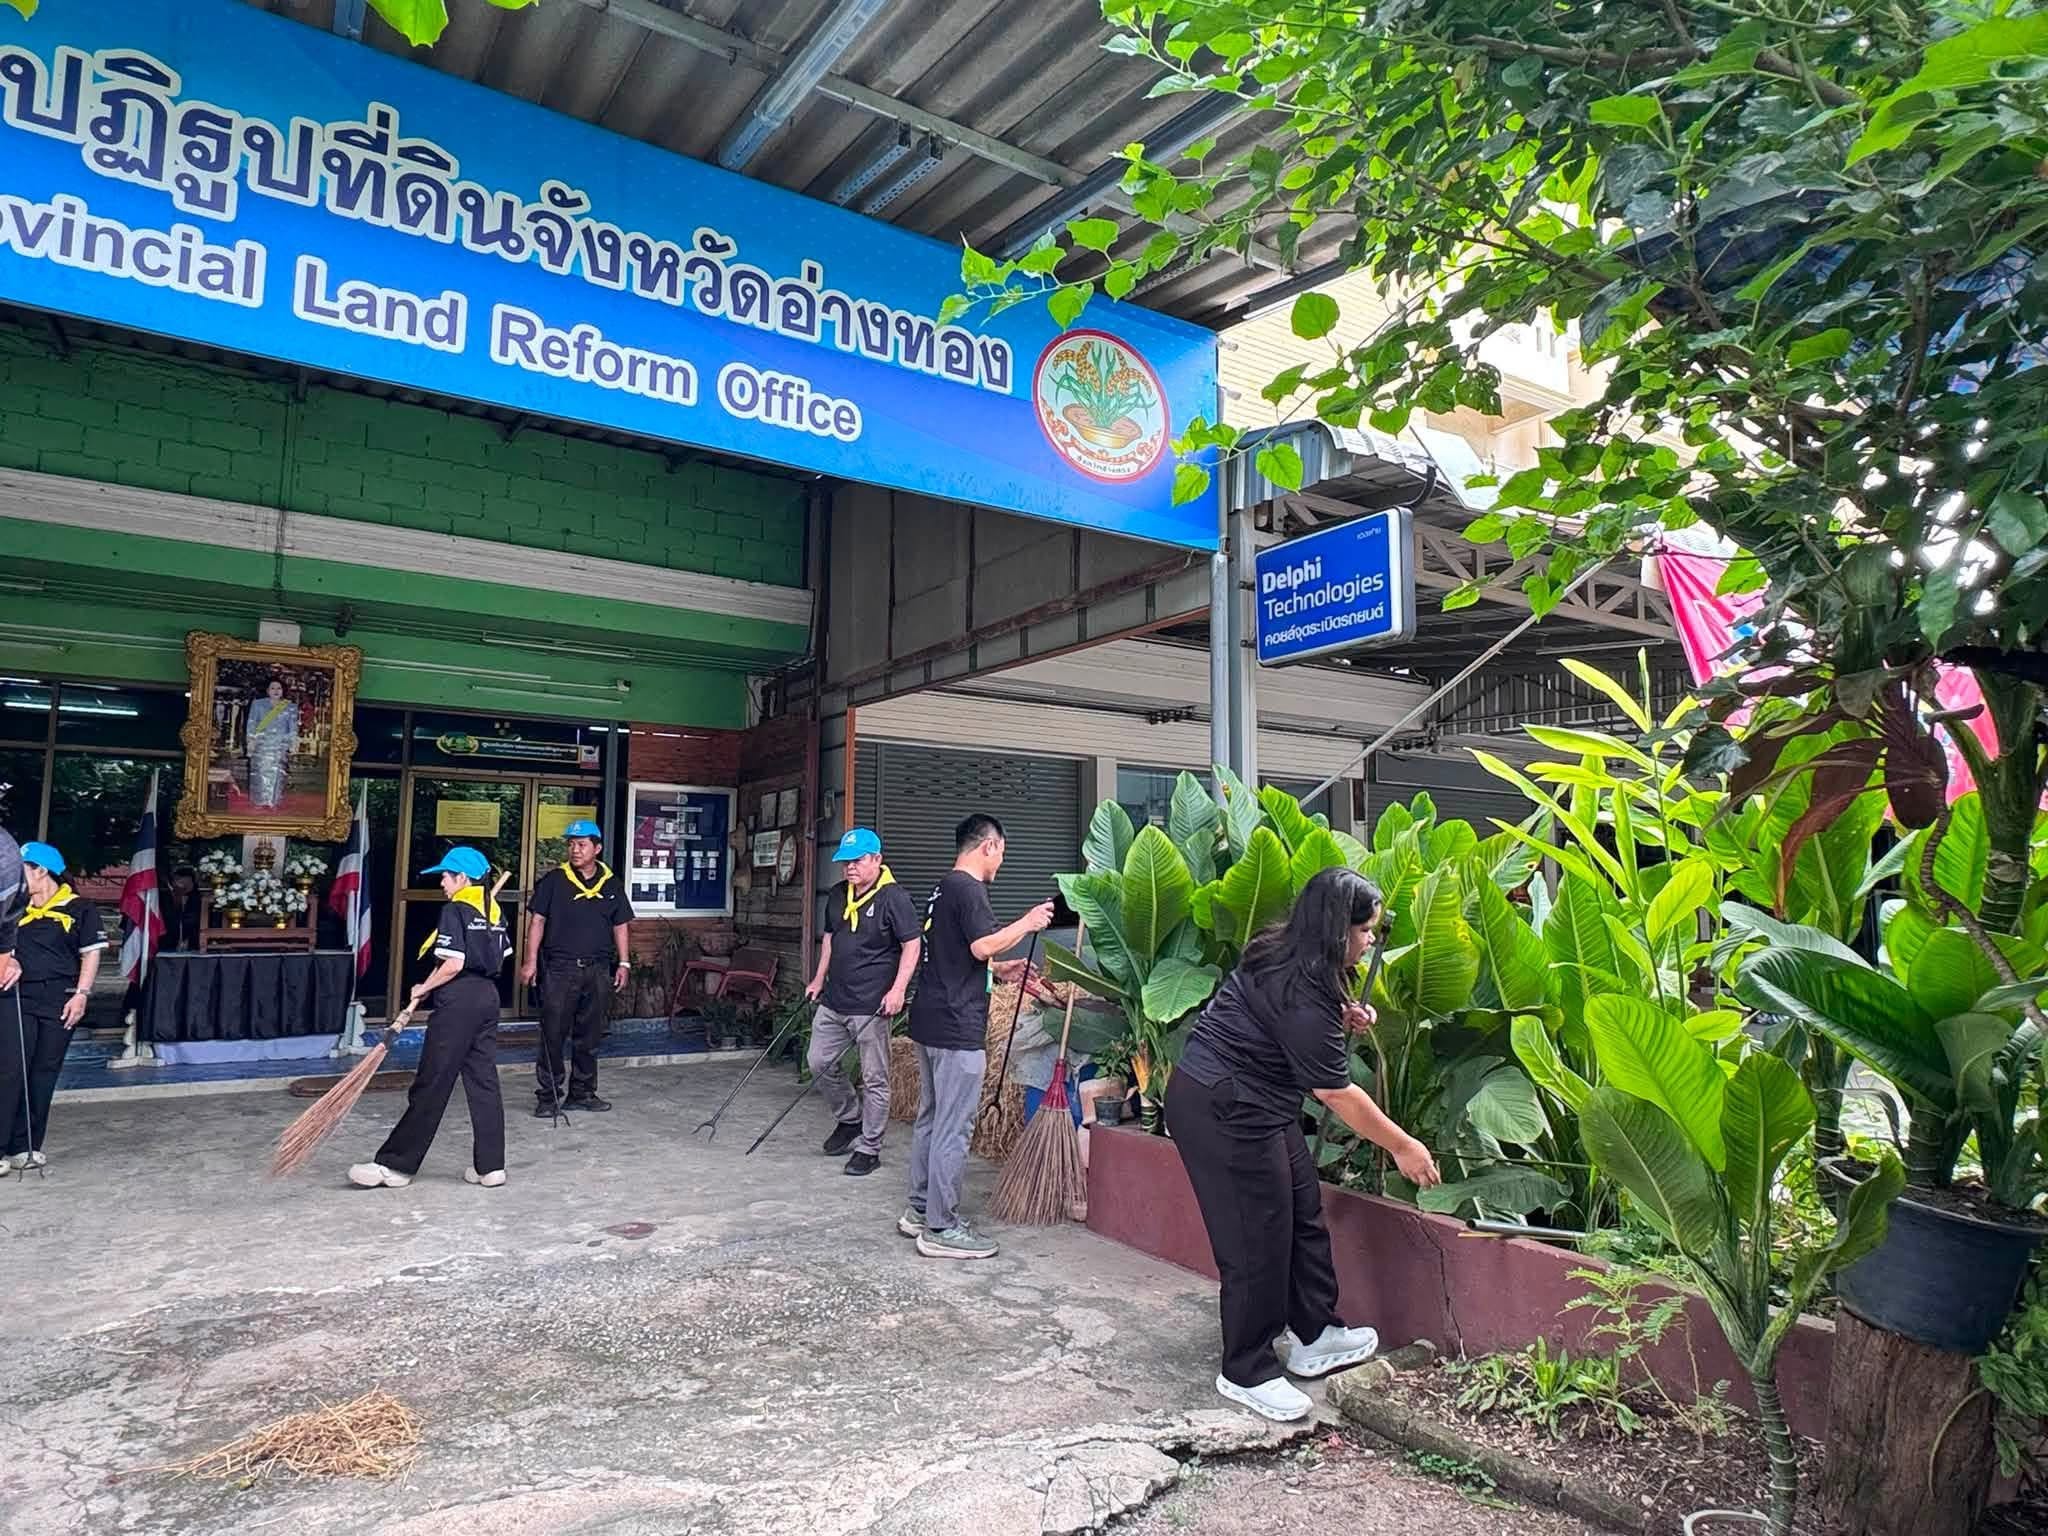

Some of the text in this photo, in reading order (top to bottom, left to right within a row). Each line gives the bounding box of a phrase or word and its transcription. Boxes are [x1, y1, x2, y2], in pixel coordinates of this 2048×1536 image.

[0, 51, 1011, 391] ปฏิรูปที่ดินจังหวัดอ่างทอง
[0, 203, 857, 436] vincial Land Reform Office
[1262, 557, 1321, 594] Delphi
[1263, 573, 1384, 620] Technologies
